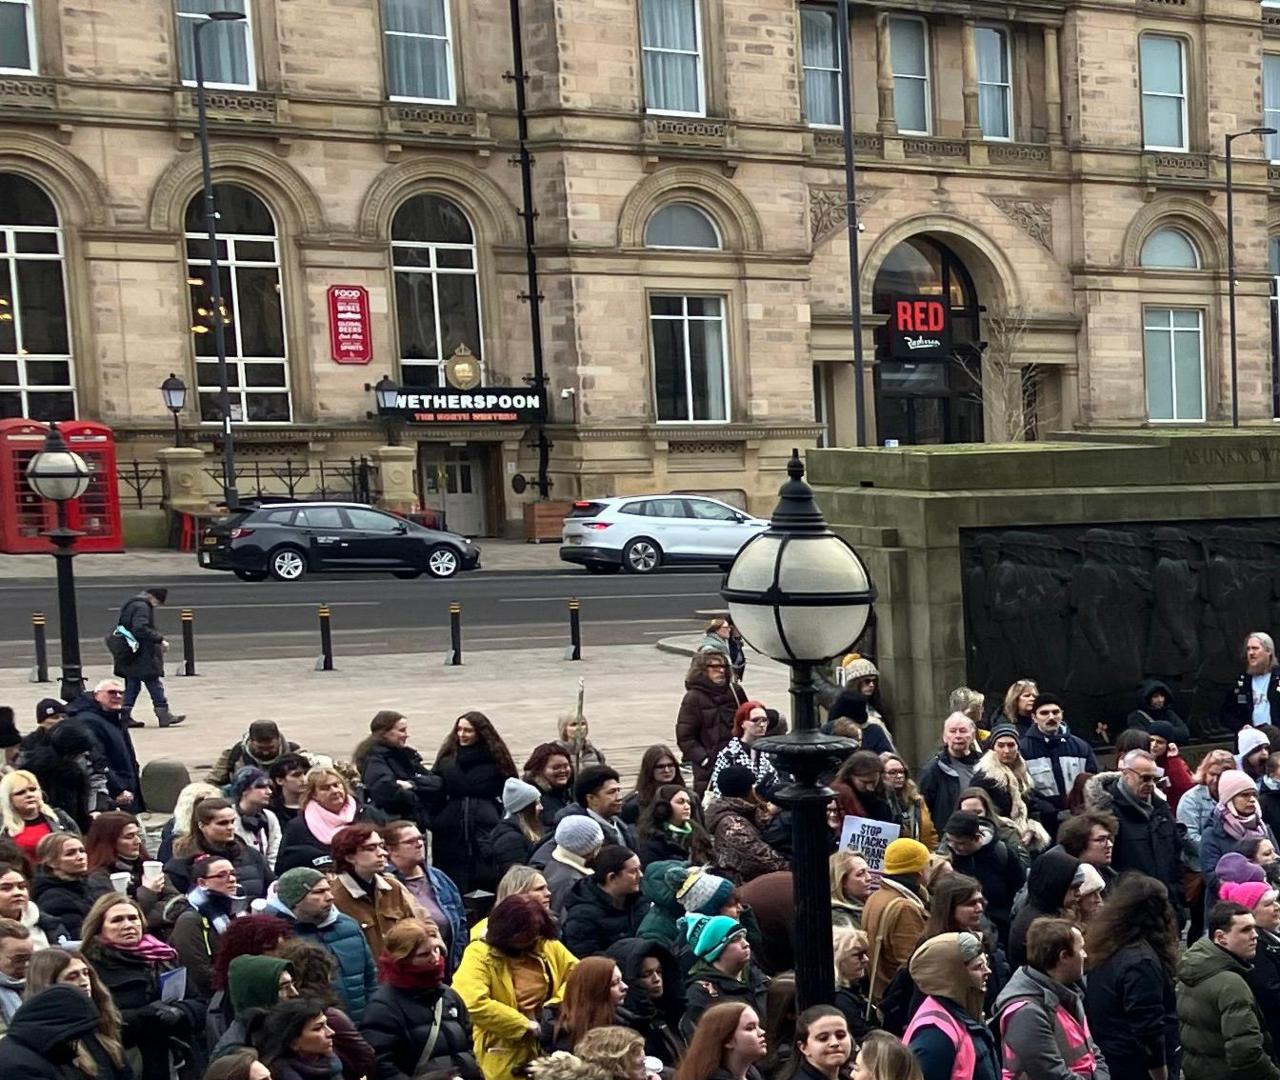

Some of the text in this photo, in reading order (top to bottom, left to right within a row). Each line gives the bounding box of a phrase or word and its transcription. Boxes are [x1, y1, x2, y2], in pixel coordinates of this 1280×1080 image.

[335, 289, 360, 297] FOOD
[896, 301, 945, 332] RED
[395, 394, 540, 409] WETHERSPOON
[414, 412, 435, 421] THE
[860, 824, 882, 837] STOP
[850, 833, 888, 849] ATTACKS
[860, 846, 885, 860] TRAN
